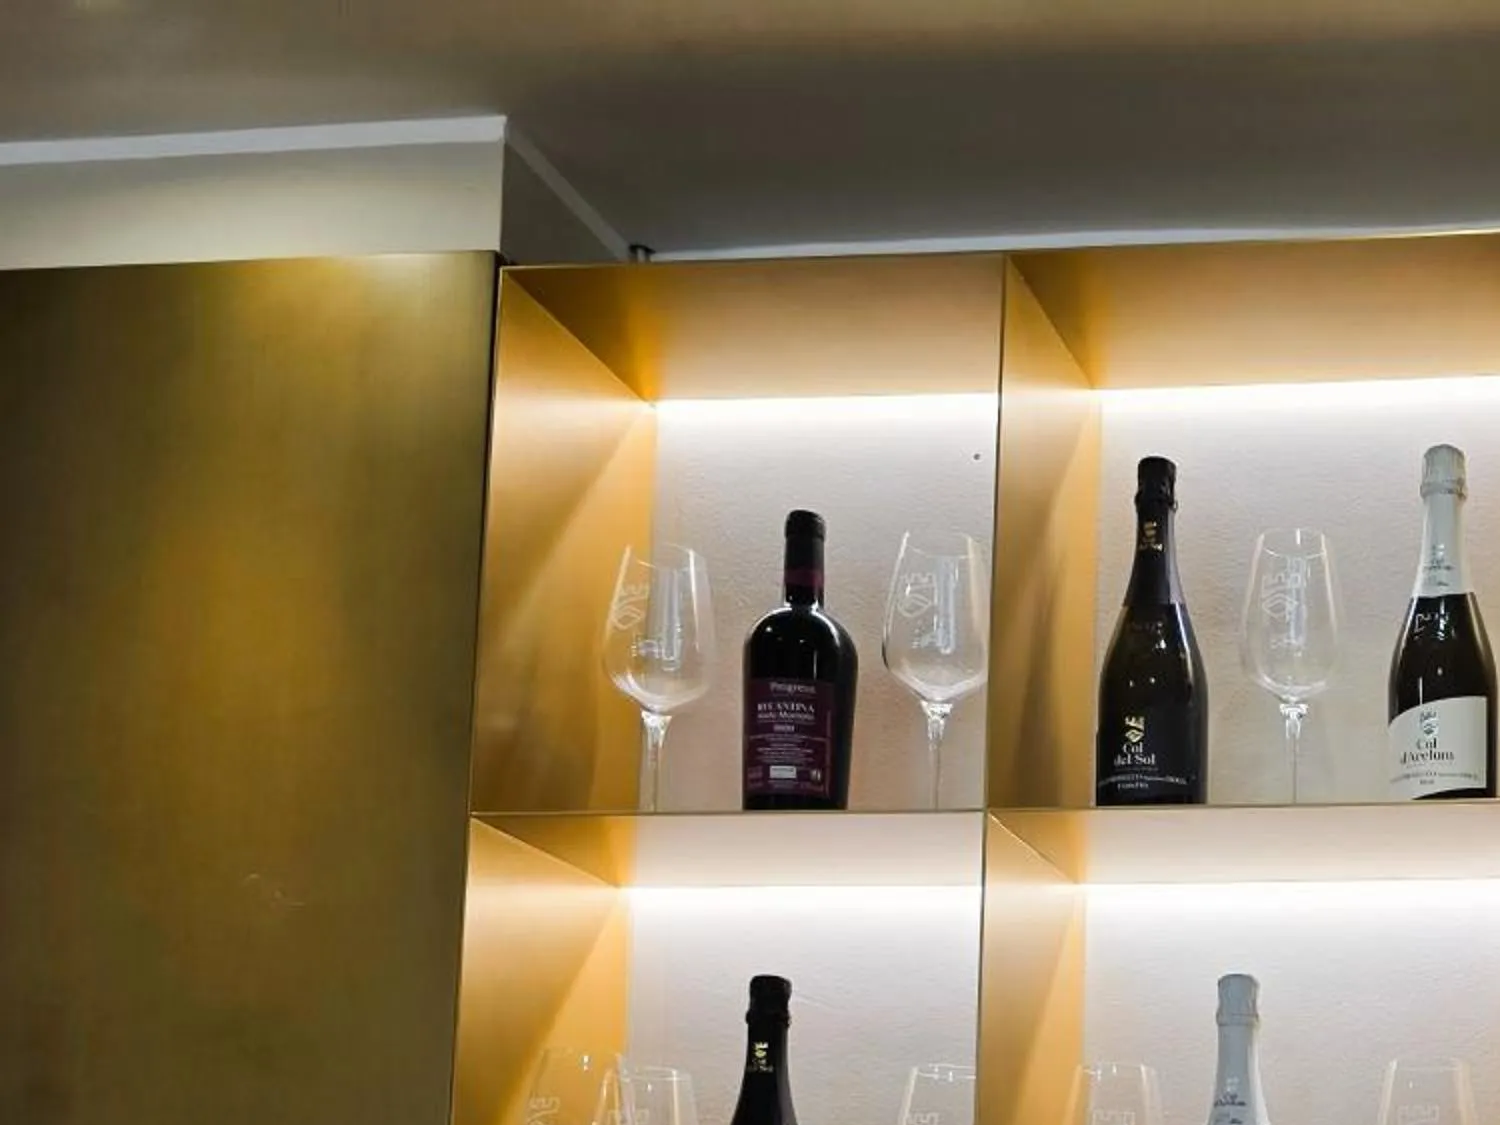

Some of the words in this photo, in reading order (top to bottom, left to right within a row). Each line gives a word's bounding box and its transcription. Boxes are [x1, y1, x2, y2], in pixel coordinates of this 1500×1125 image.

[1122, 742, 1143, 753] Col
[1416, 738, 1437, 750] Col
[1134, 753, 1155, 765] Sol
